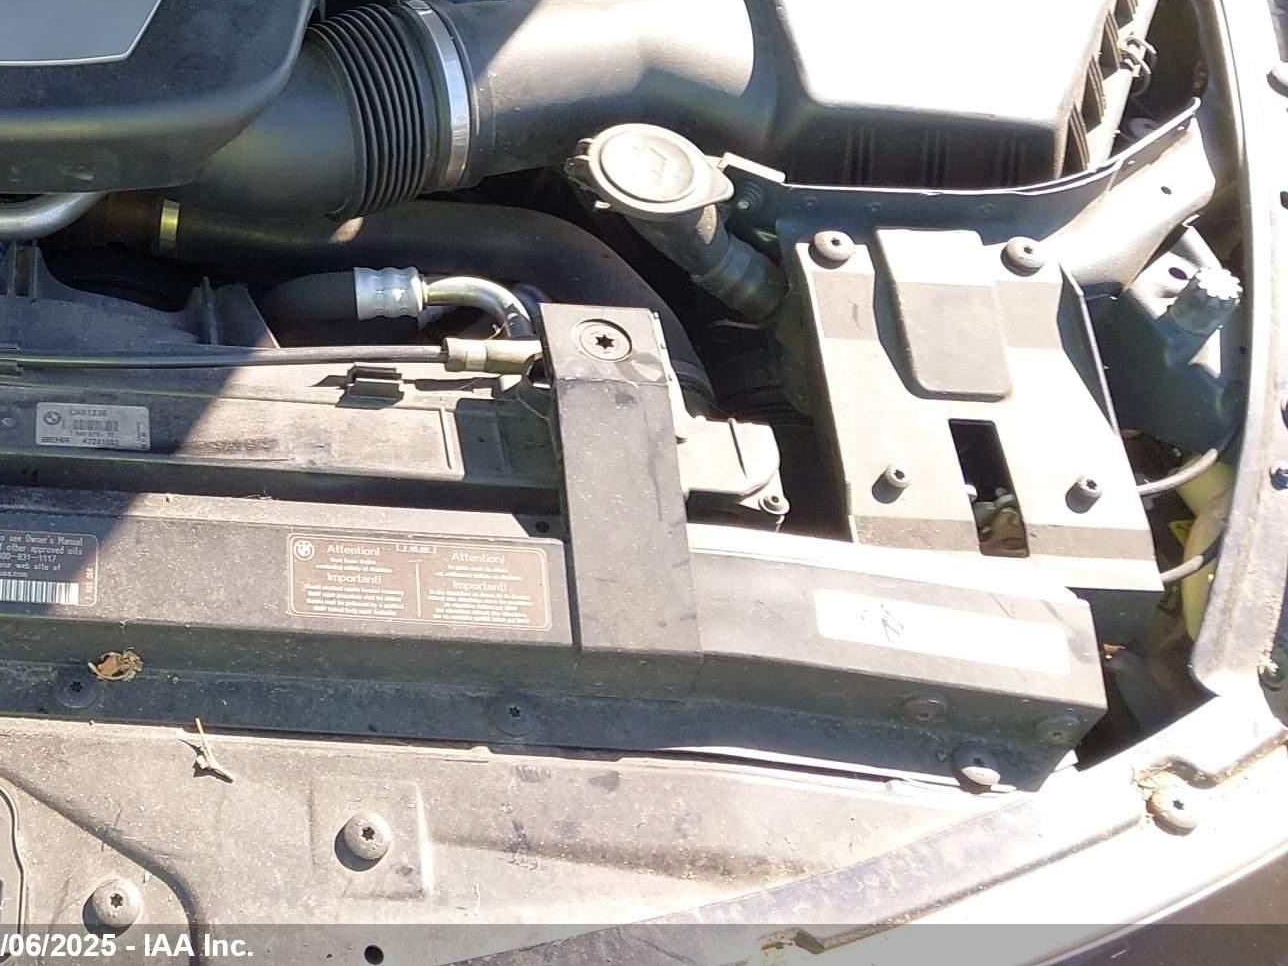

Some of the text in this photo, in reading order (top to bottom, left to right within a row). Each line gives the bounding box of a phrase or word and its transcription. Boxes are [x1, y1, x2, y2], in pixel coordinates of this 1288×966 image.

[25, 533, 54, 545] Owner's
[58, 536, 83, 546] Manual
[6, 543, 27, 553] other
[30, 545, 64, 556] approved
[67, 546, 83, 556] oils
[327, 544, 380, 556] Attention!
[452, 552, 505, 564] Attention!
[14, 560, 31, 569] web
[34, 561, 49, 571] site
[53, 562, 61, 571] at
[327, 572, 382, 585] Important!
[452, 580, 507, 592] Important!
